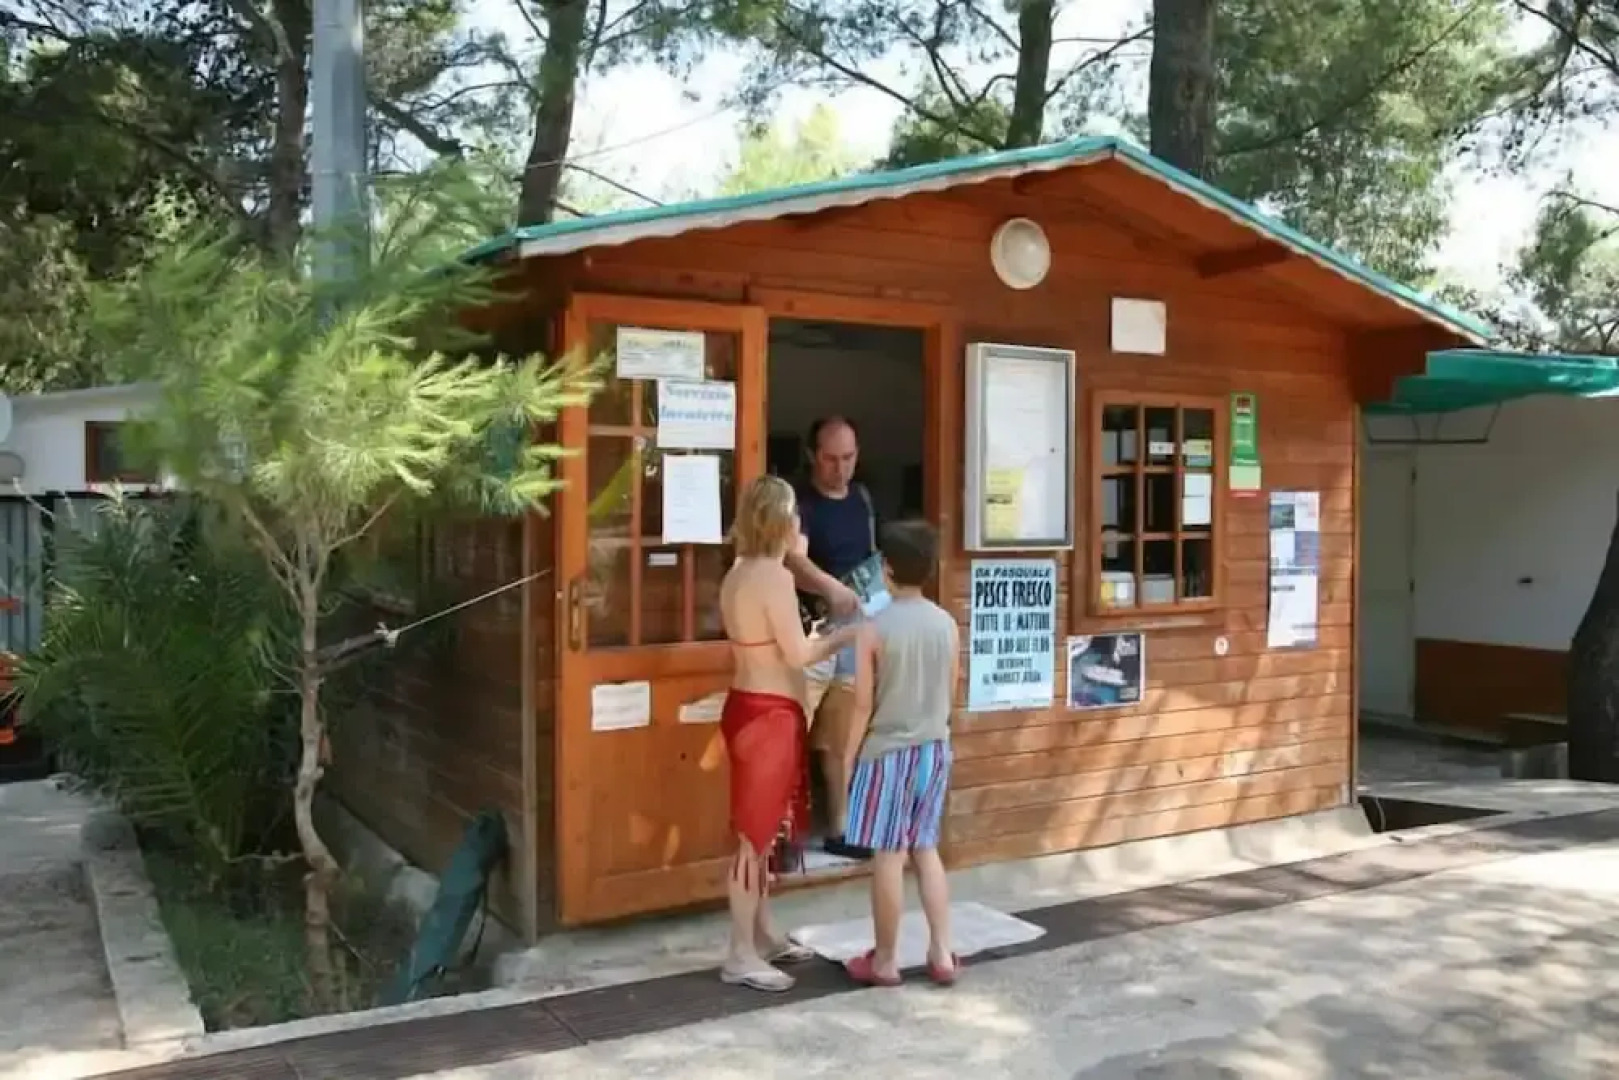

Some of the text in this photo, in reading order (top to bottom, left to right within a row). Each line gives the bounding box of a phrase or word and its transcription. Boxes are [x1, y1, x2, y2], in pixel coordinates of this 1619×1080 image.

[994, 567, 1051, 578] PASQUALE
[975, 581, 1052, 607] PESCE FRESCO
[975, 613, 998, 631] TUTTE
